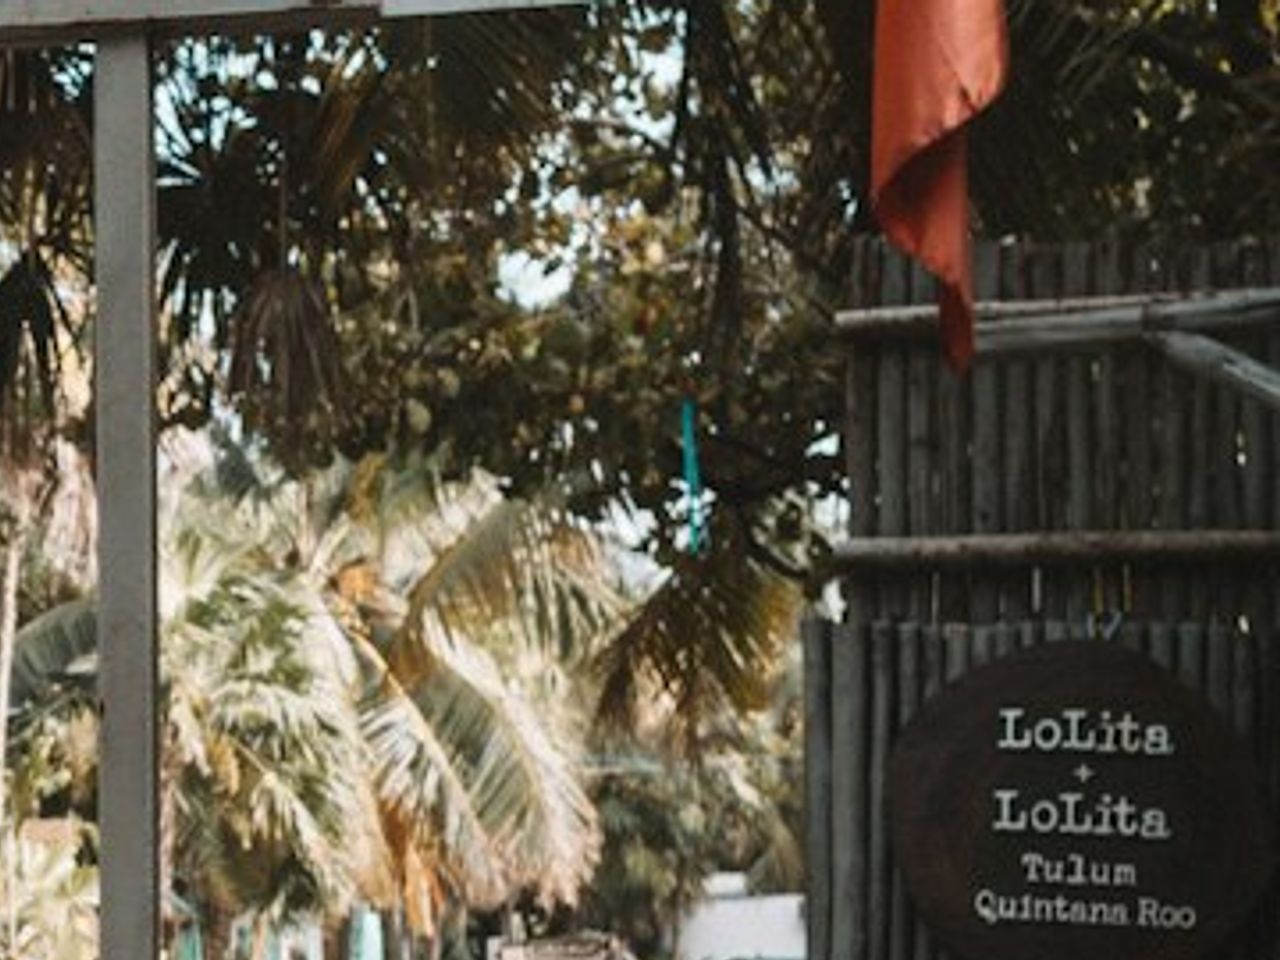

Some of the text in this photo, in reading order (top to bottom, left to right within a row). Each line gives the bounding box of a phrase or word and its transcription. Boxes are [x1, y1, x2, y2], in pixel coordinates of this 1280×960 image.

[997, 707, 1174, 755] LoLita
[991, 789, 1171, 838] LoLita
[1021, 853, 1136, 885] Tulum
[973, 888, 1197, 930] Quintana Roo
